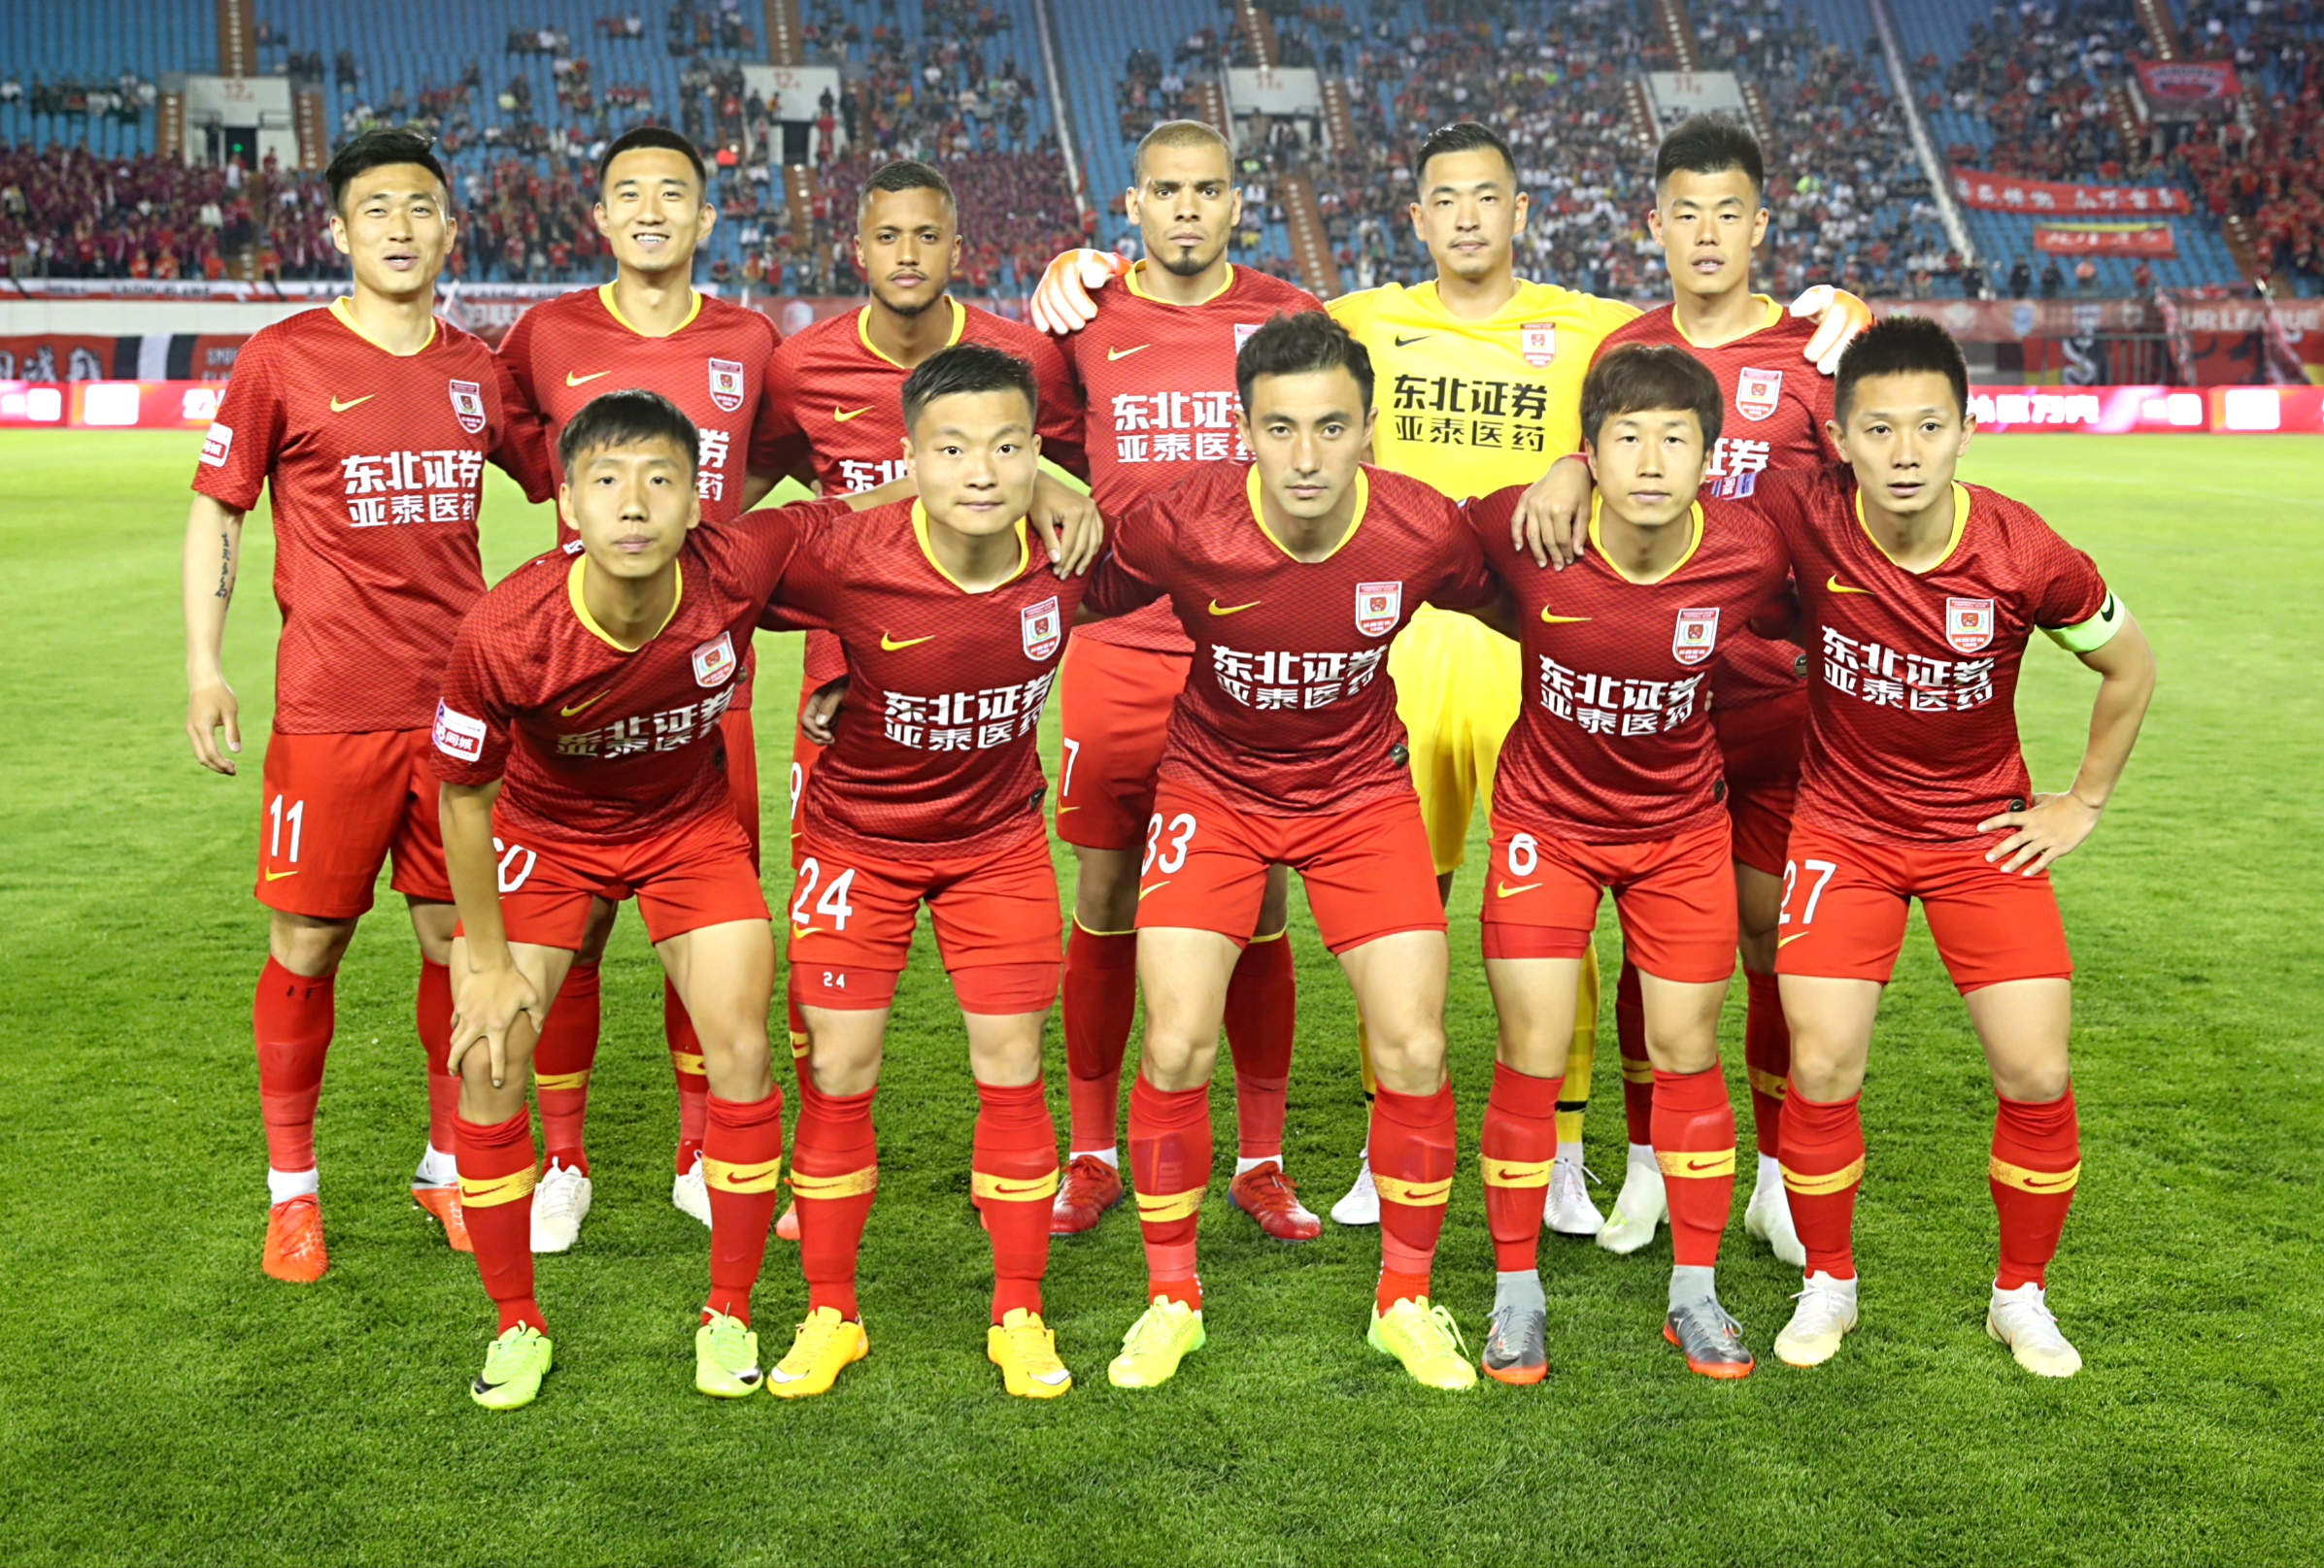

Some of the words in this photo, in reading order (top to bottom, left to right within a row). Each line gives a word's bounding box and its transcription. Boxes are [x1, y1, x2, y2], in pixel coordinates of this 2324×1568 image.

[2220, 308, 2321, 331] LEAUE
[1111, 390, 1244, 431] 东北证
[1394, 374, 1547, 419] 东北证券
[1394, 415, 1546, 452] 亚泰医药
[341, 450, 483, 495] 东北证券
[839, 459, 908, 493] 东北
[1211, 644, 1388, 685] 东北证券
[1539, 653, 1705, 711] 东北证券
[1822, 624, 1995, 687] 东北证券
[883, 666, 1058, 726] 东北证券
[1216, 668, 1374, 711] 亚泰医药
[1540, 683, 1694, 737] 亚泰医药
[1824, 657, 1993, 711] 亚泰医药
[884, 697, 1046, 751] 亚泰医药
[270, 794, 304, 862] 11
[1141, 813, 1196, 877] 33
[1508, 833, 1538, 877] 6
[492, 837, 537, 892] 0
[1778, 859, 1837, 924] 27
[792, 857, 856, 931] 24
[823, 971, 845, 988] 24
